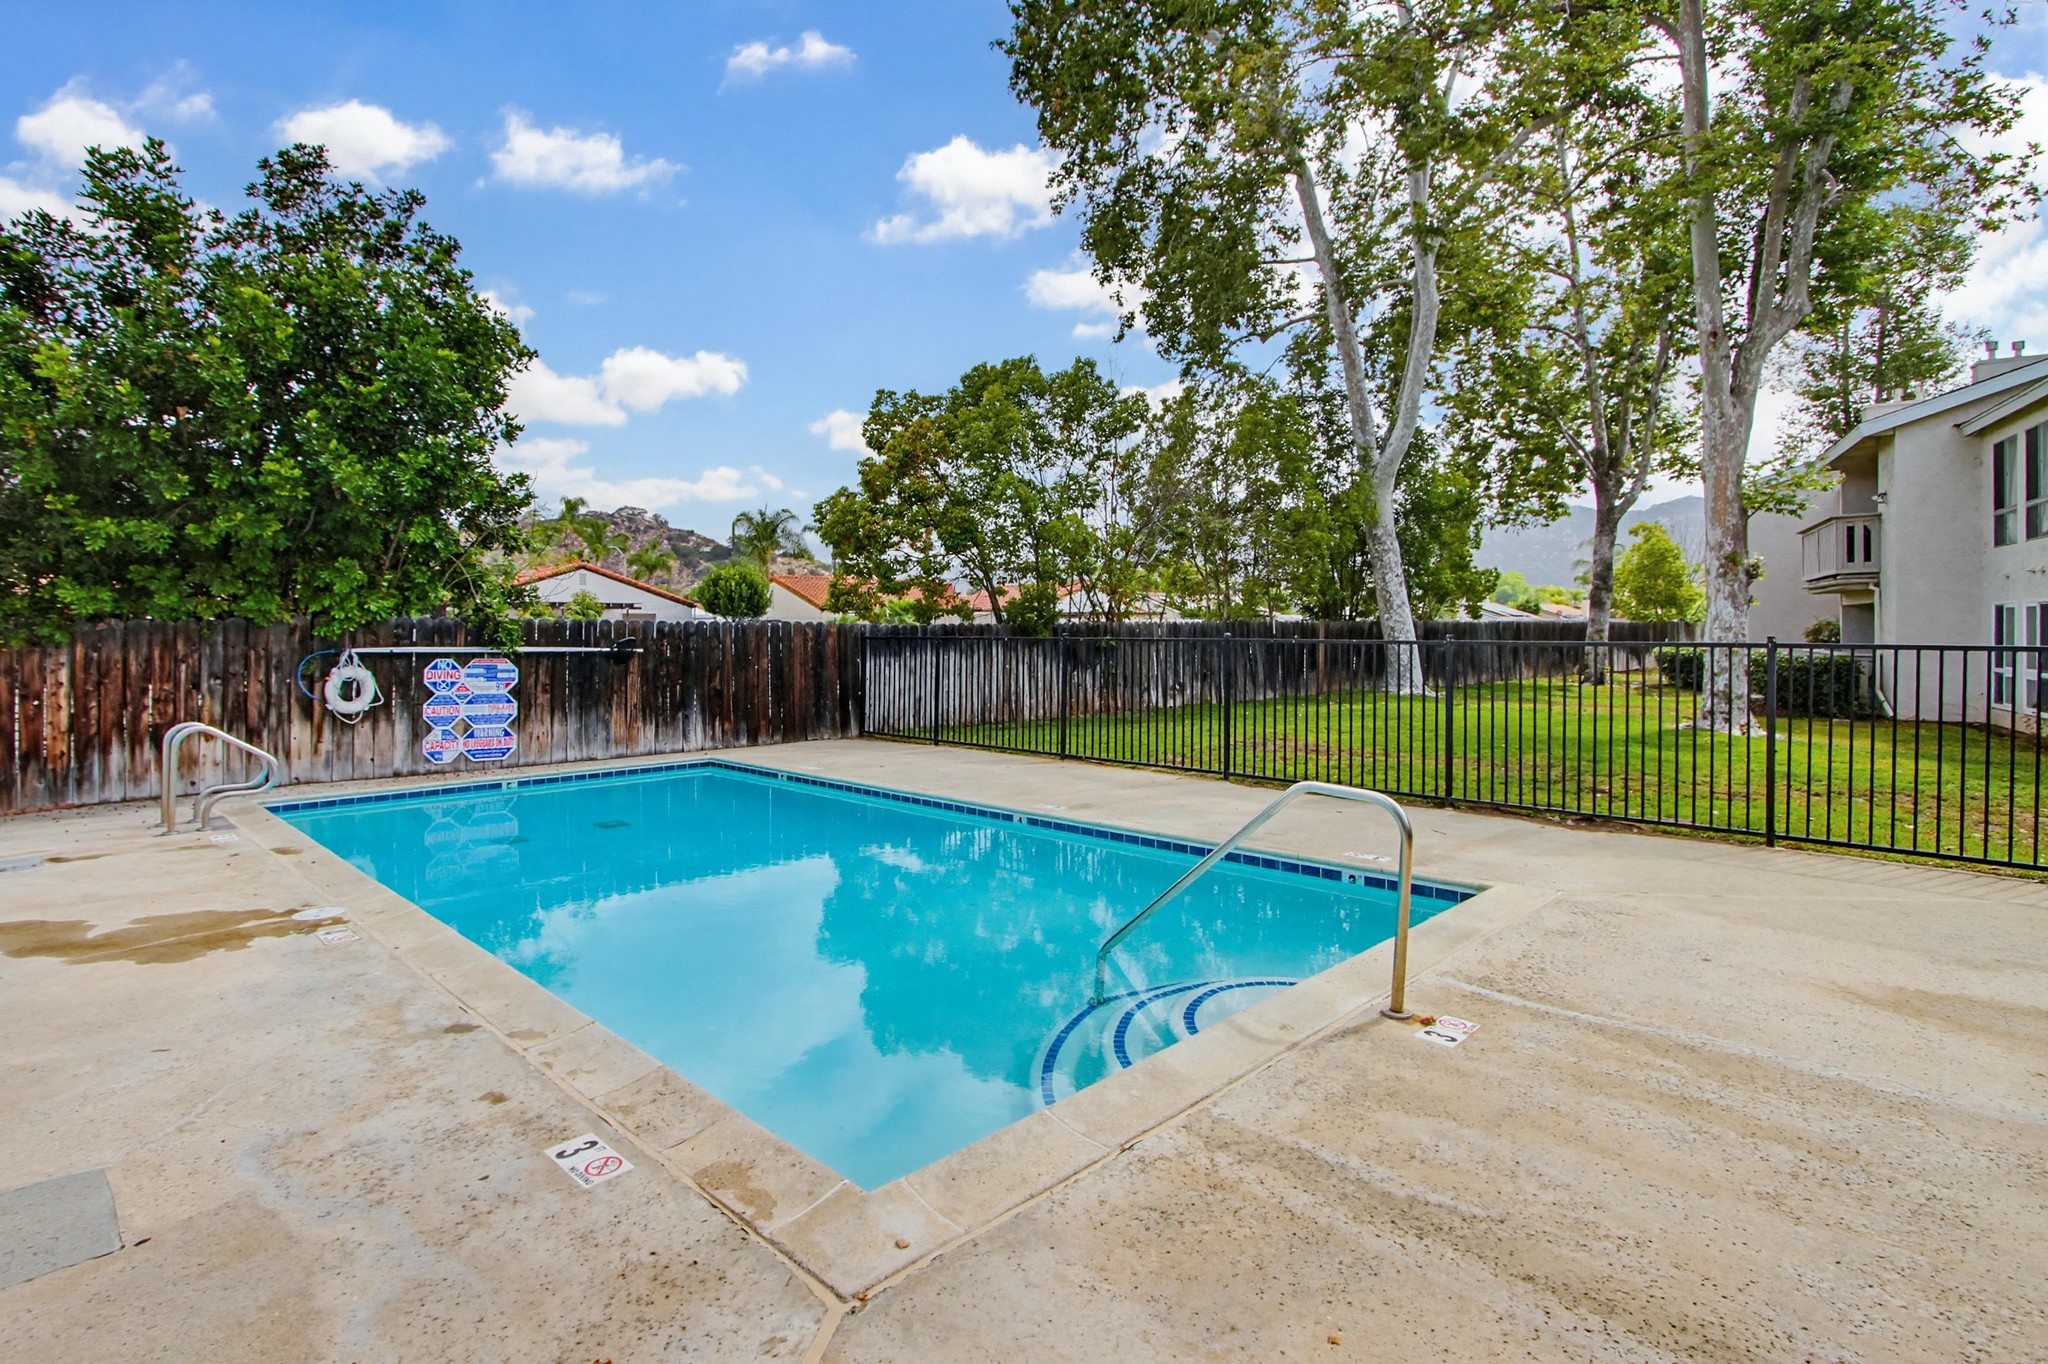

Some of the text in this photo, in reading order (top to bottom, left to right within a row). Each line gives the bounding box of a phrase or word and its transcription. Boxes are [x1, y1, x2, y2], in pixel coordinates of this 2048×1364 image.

[437, 660, 452, 670] NO
[426, 670, 461, 680] DIVING
[425, 706, 460, 715] CAUTION
[474, 727, 505, 737] WARNING
[424, 740, 459, 751] CAPACITY
[462, 739, 471, 749] NO
[471, 738, 495, 748] LIFEGUARD
[495, 737, 503, 747] ON
[1423, 1030, 1458, 1042] 3
[555, 1140, 599, 1159] 3
